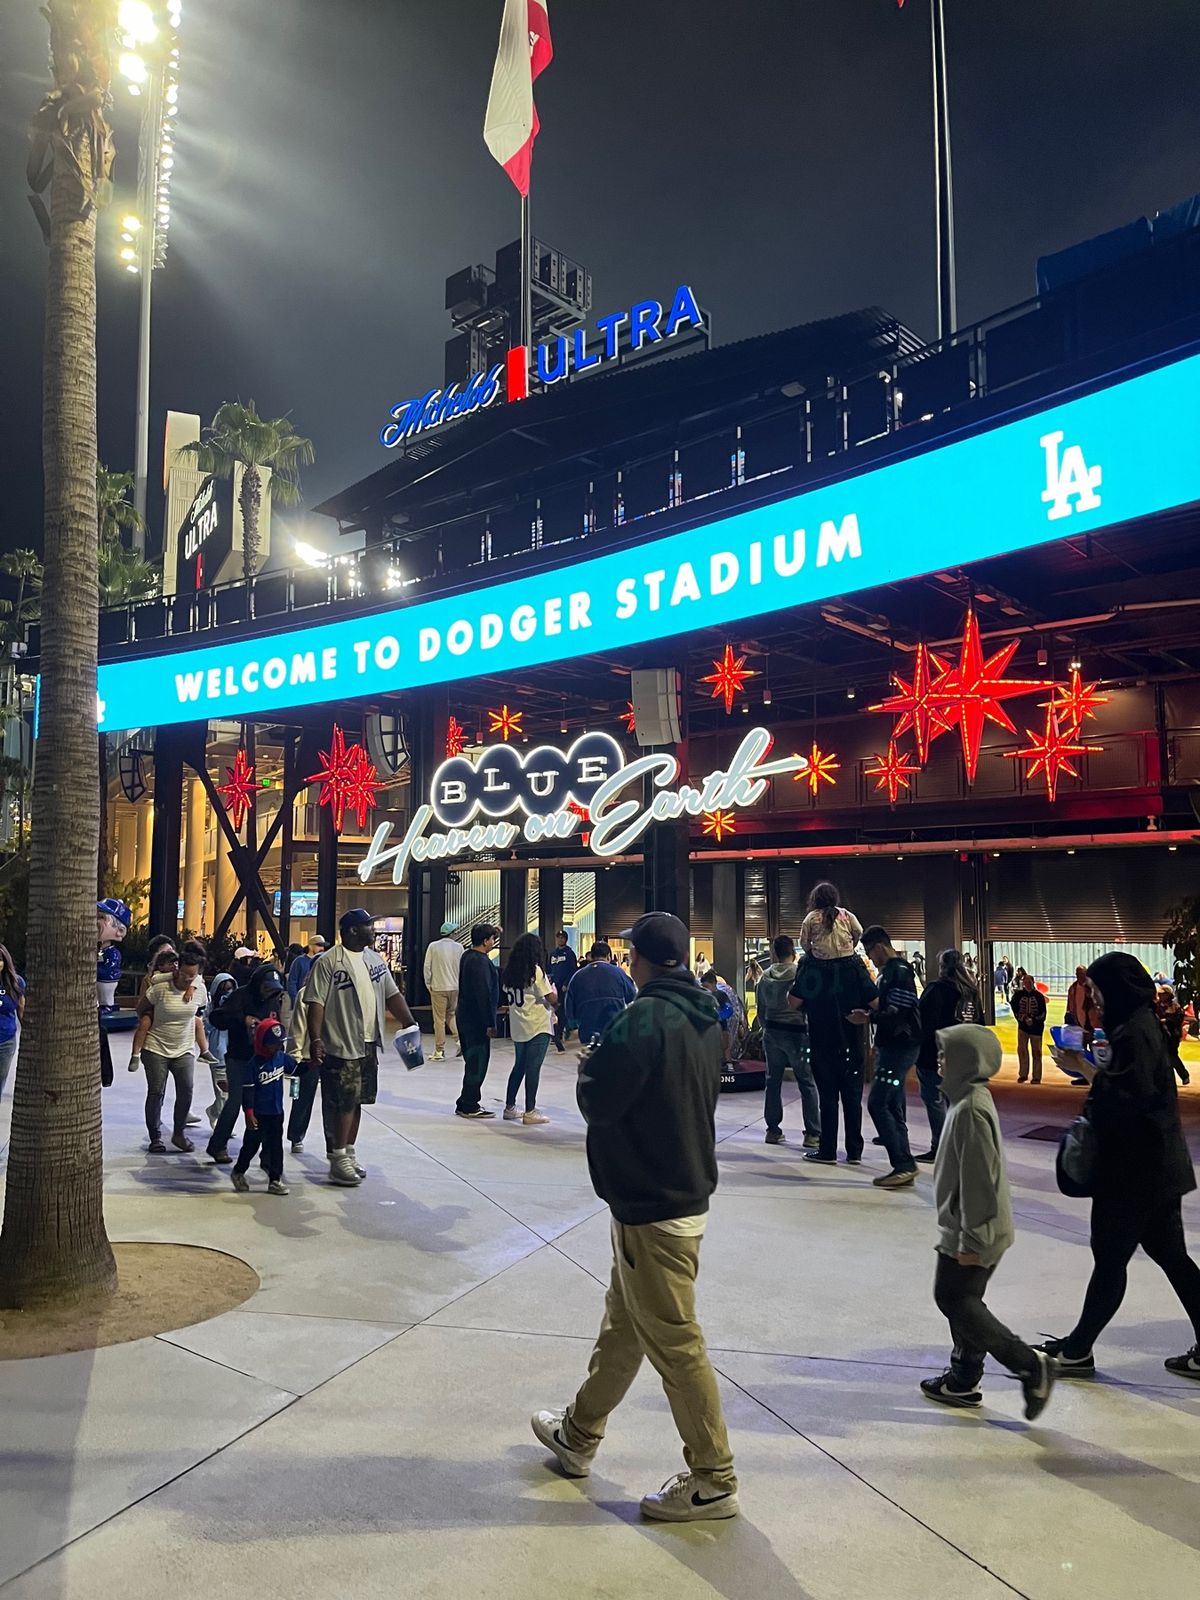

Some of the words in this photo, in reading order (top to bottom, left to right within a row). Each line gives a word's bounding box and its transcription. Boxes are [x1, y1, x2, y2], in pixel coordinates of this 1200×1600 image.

[379, 363, 506, 448] Michelob
[537, 285, 704, 385] ULTRA
[184, 501, 218, 560] ULTRA
[1040, 430, 1102, 520] LA
[175, 648, 337, 703] WELCOME
[353, 638, 401, 674] TO
[418, 591, 592, 662] DODGER
[615, 513, 862, 620] STADIUM
[358, 804, 520, 885] Heaven
[523, 811, 581, 842] on
[589, 726, 808, 857] Earth
[439, 755, 609, 805] BLUE
